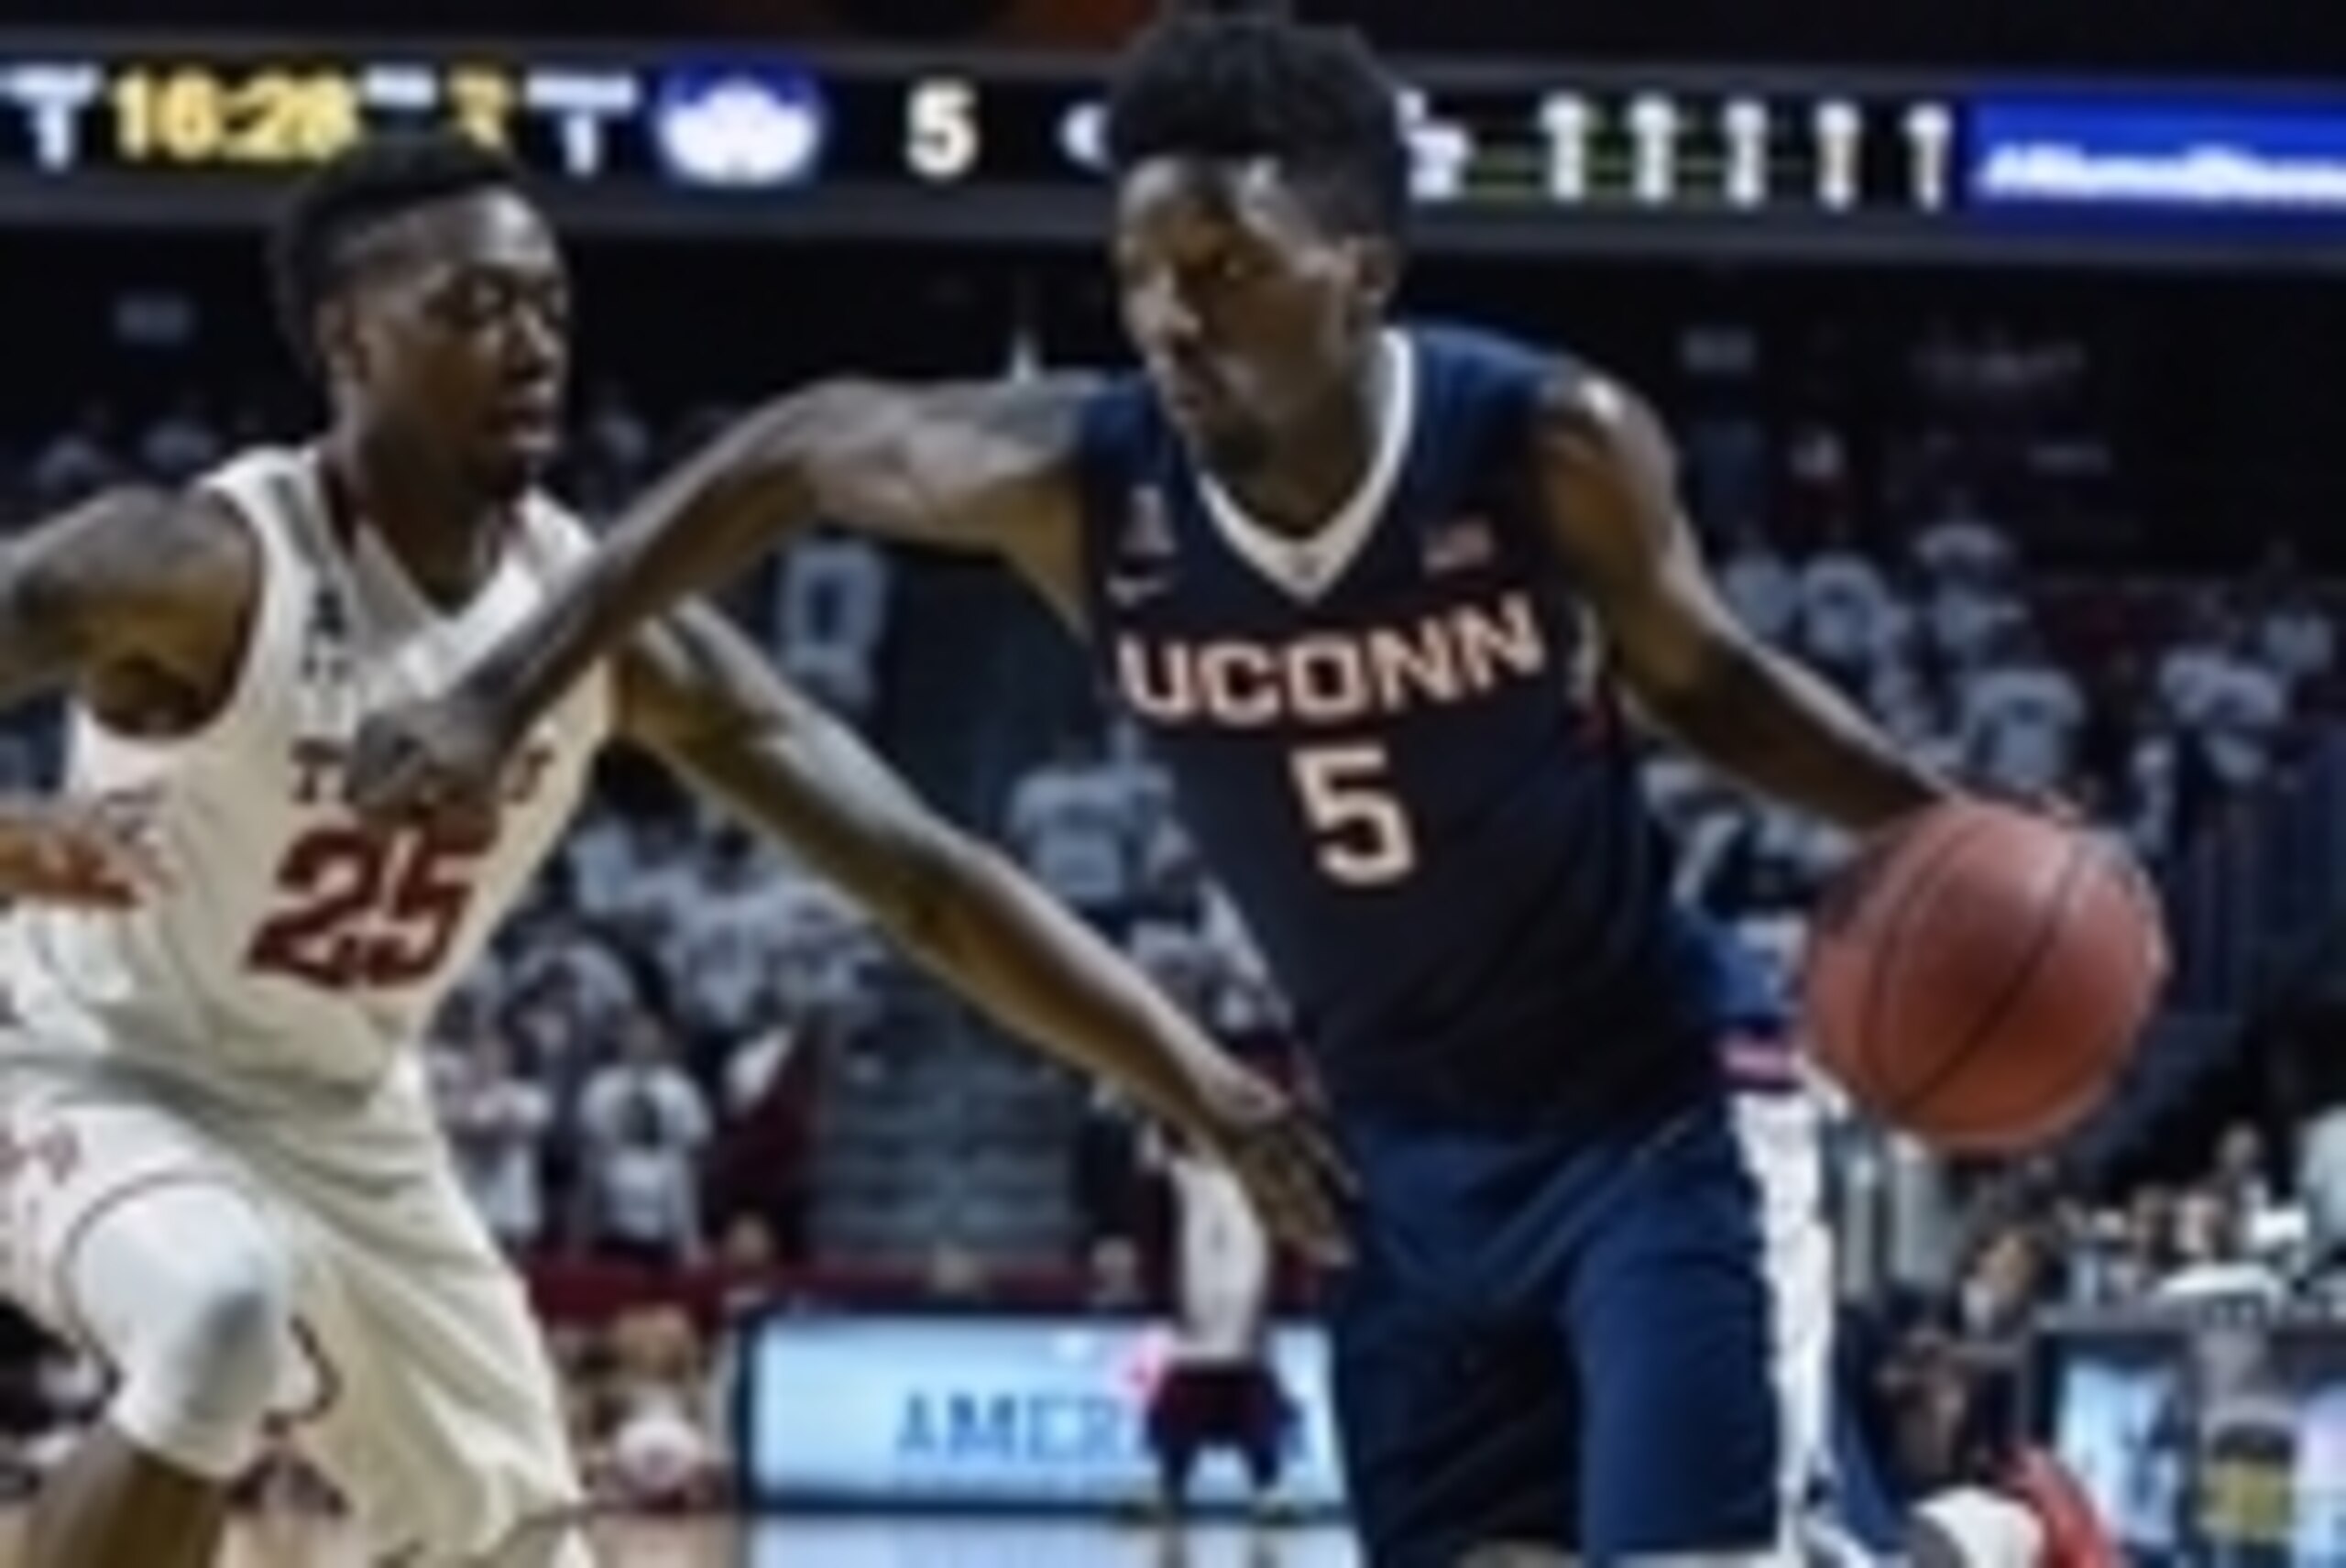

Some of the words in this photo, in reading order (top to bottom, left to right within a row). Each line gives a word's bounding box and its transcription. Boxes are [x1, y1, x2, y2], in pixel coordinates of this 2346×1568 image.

[905, 75, 981, 178] 5
[1117, 593, 1547, 728] UCONN
[1289, 742, 1417, 887] 5
[244, 821, 500, 990] 25
